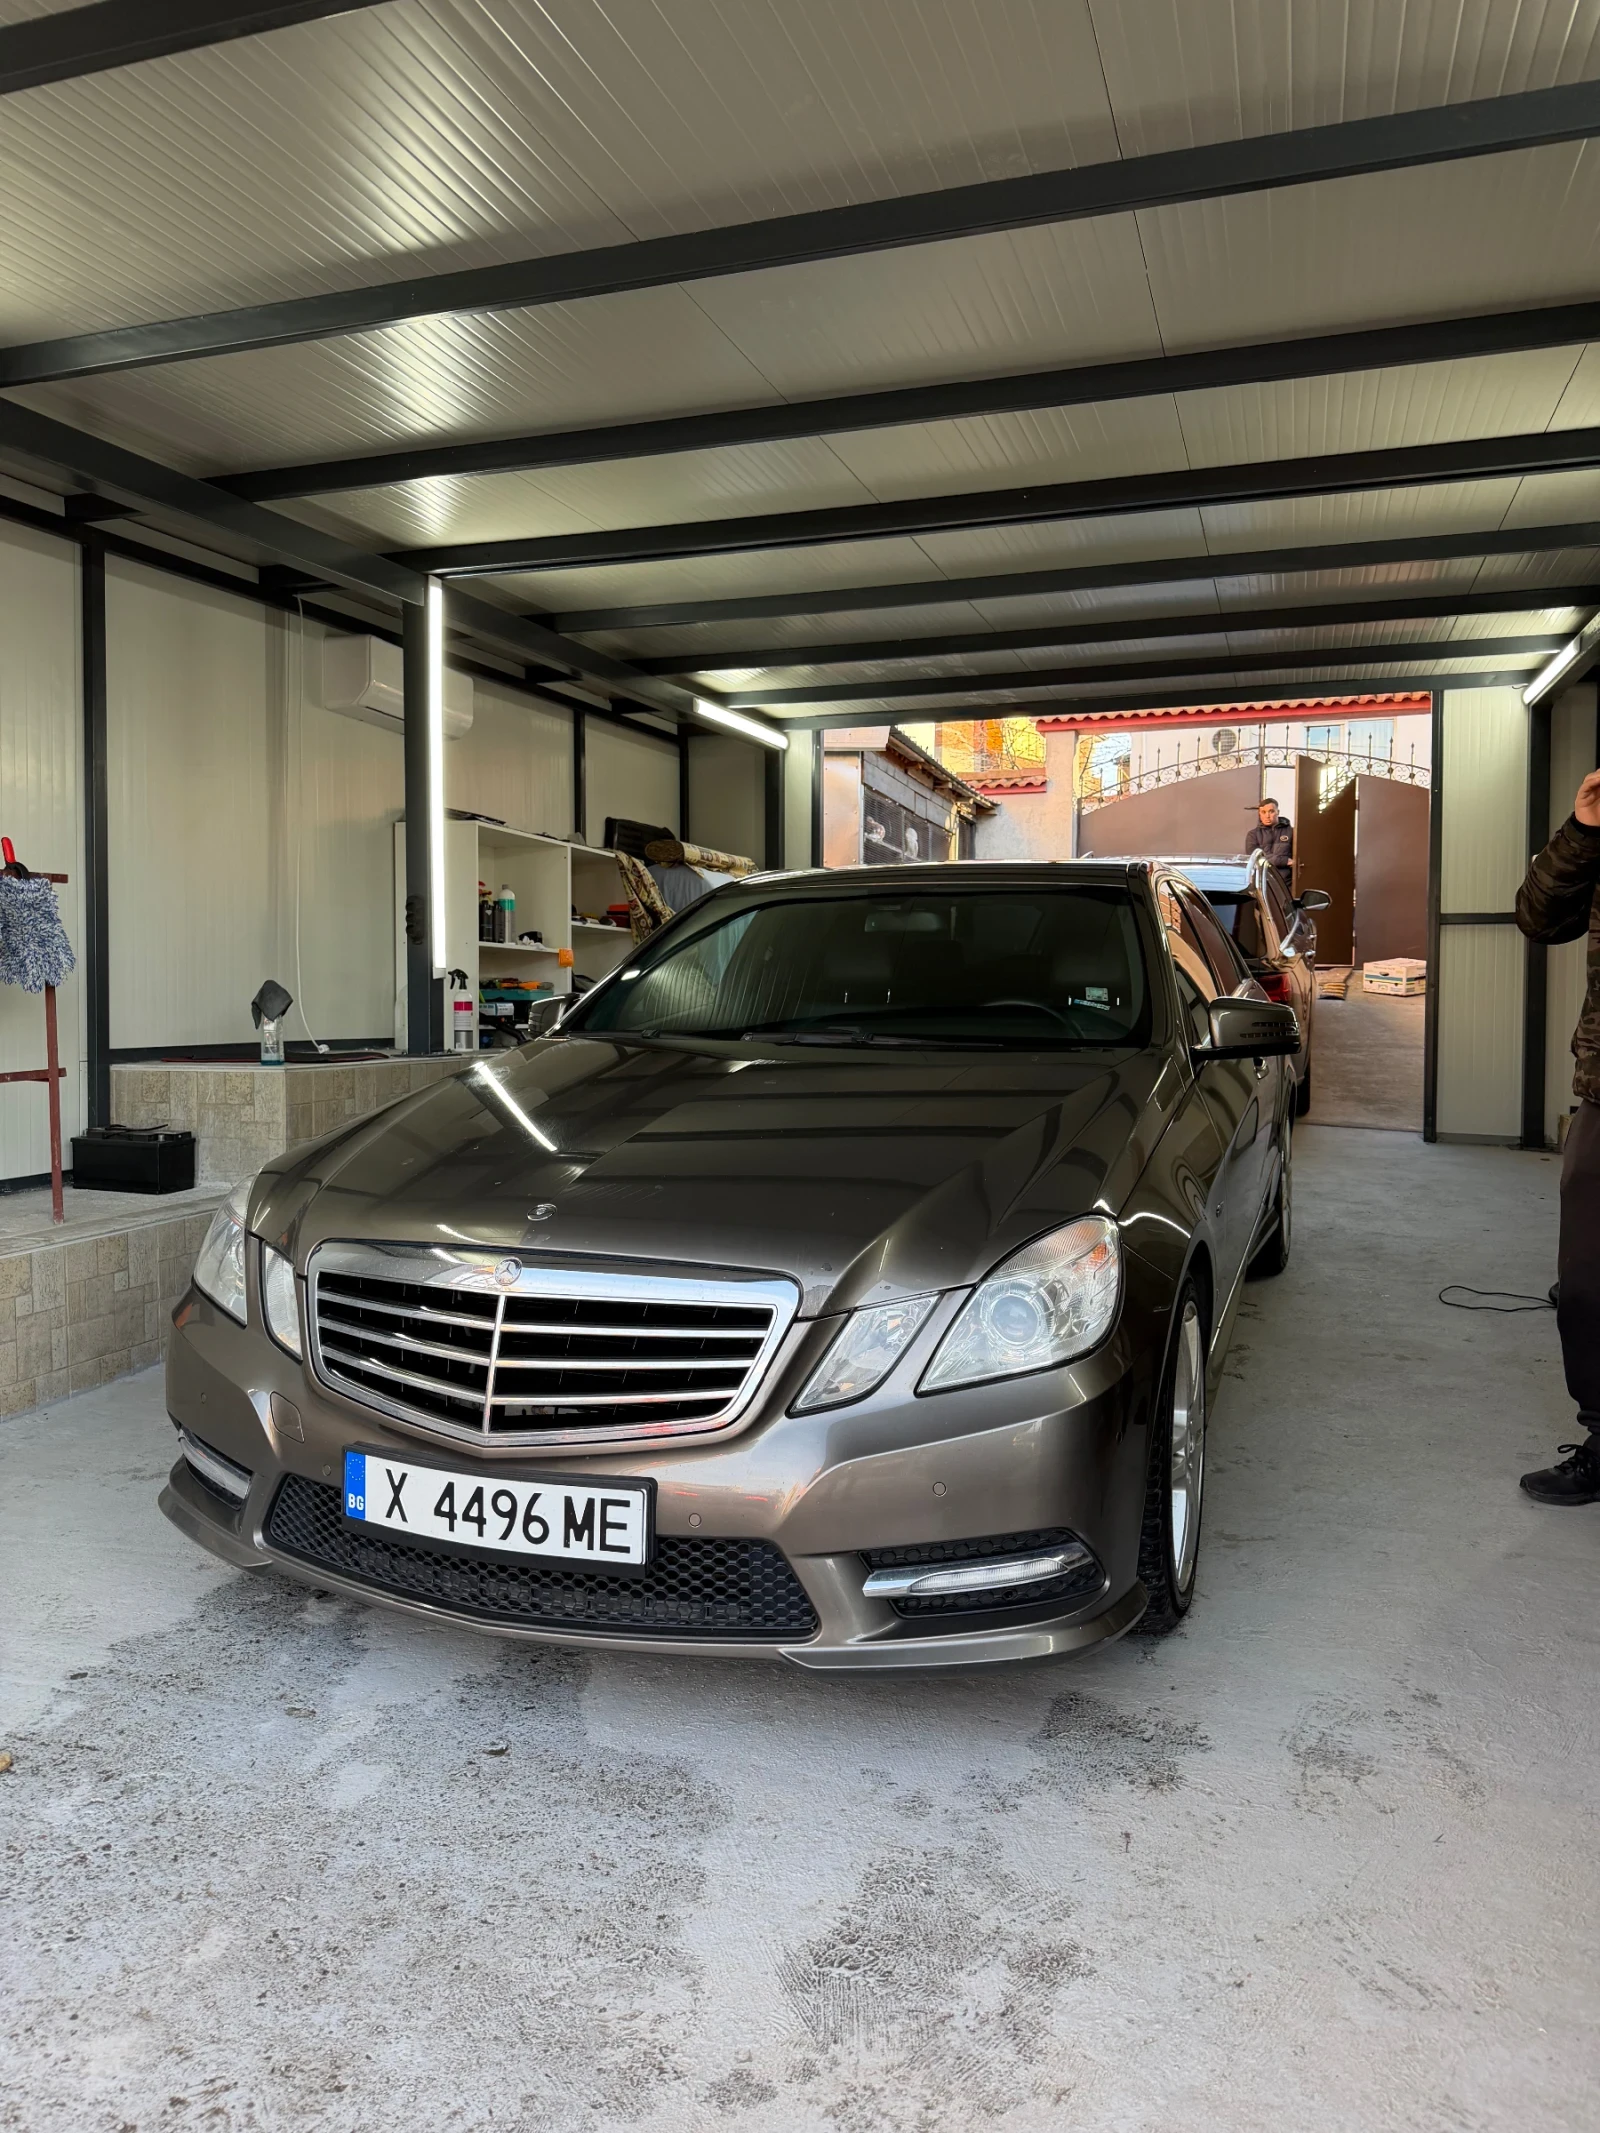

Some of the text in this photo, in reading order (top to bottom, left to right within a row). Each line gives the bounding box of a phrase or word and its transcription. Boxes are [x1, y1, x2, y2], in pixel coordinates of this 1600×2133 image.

[347, 1493, 365, 1511] BG
[385, 1468, 631, 1554] X 4496 ME
